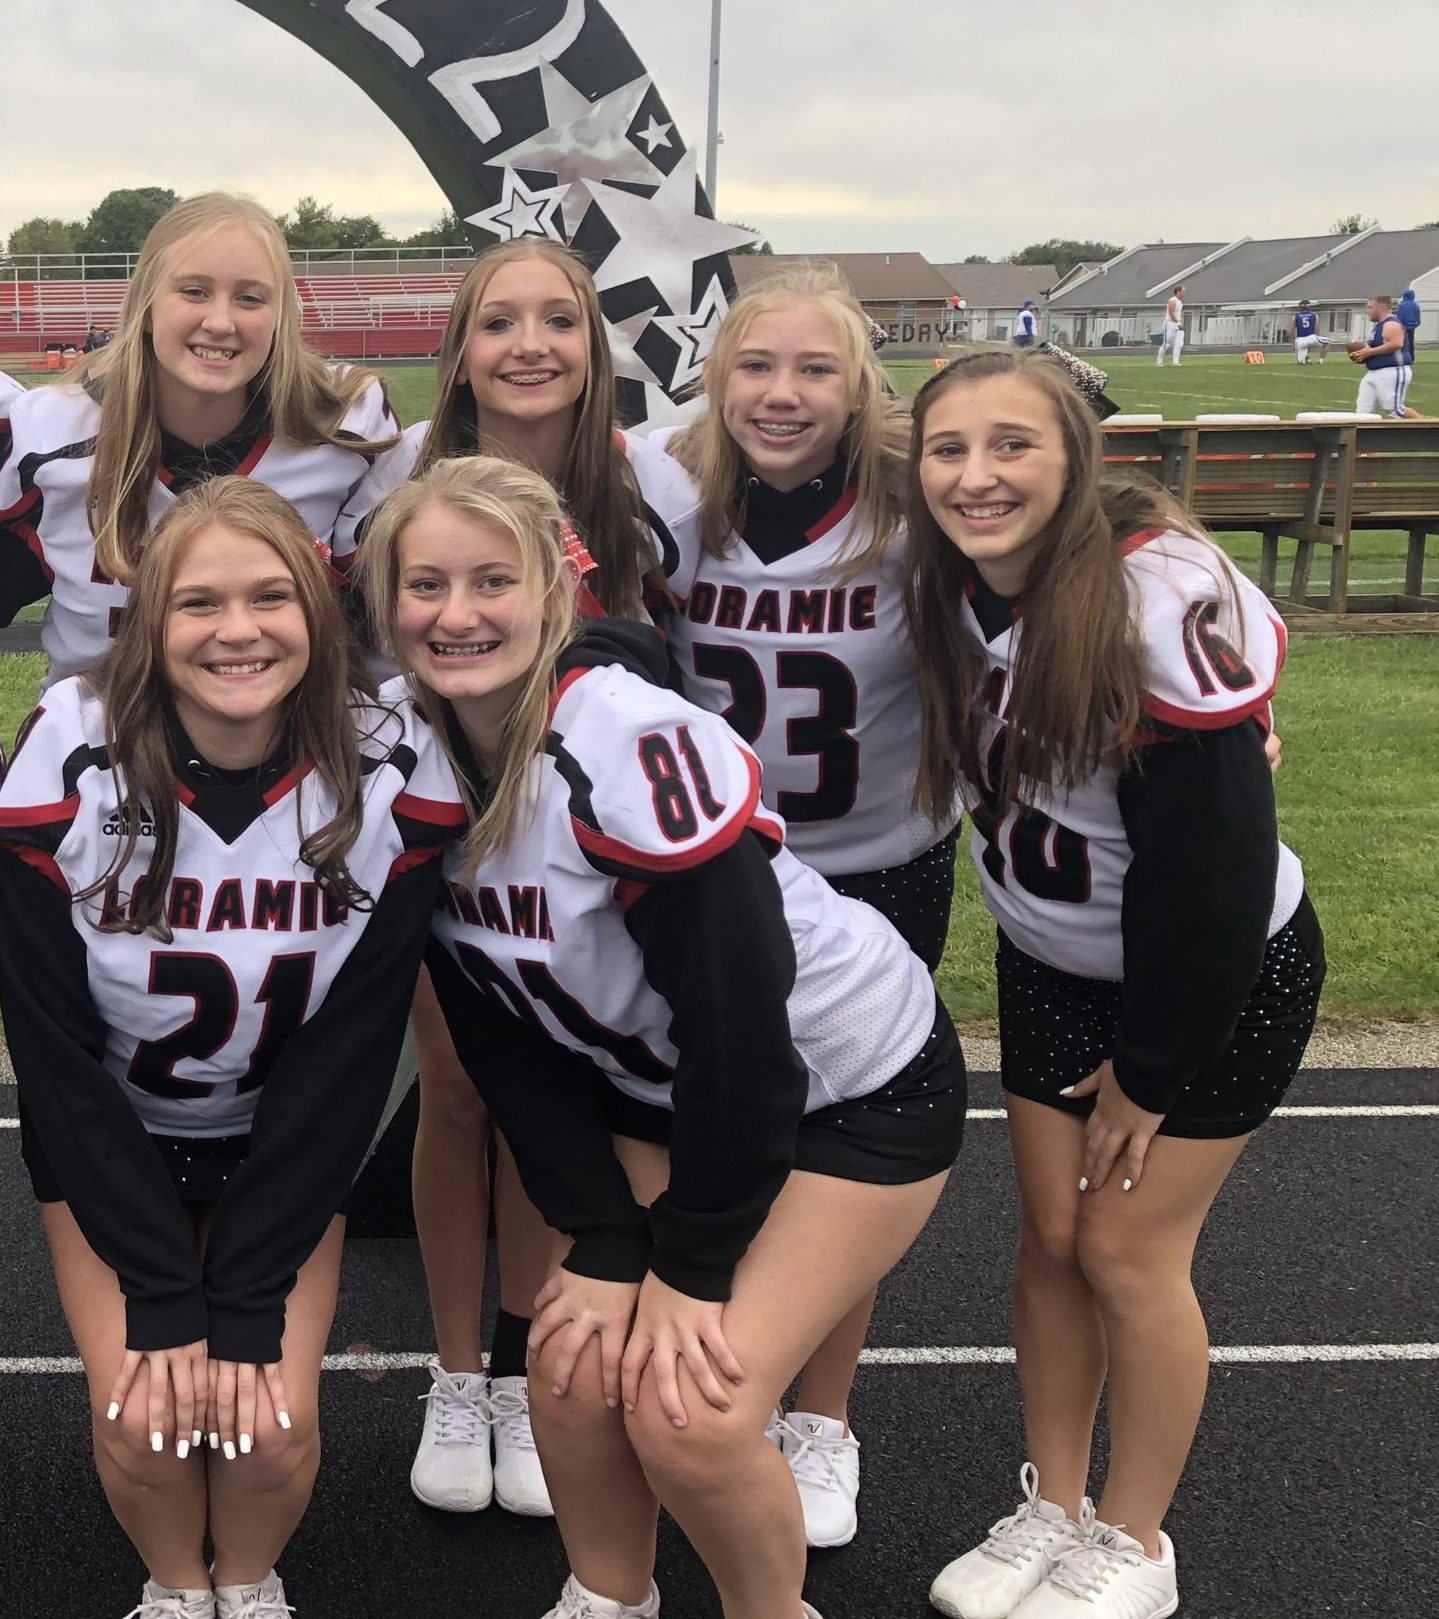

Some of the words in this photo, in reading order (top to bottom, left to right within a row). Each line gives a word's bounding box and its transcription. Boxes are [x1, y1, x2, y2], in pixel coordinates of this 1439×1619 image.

[1302, 317, 1310, 328] 5
[675, 578, 877, 633] ORAMIE
[1181, 600, 1257, 697] 16
[639, 725, 727, 843] 81
[103, 820, 160, 837] adias
[127, 951, 317, 1099] 21
